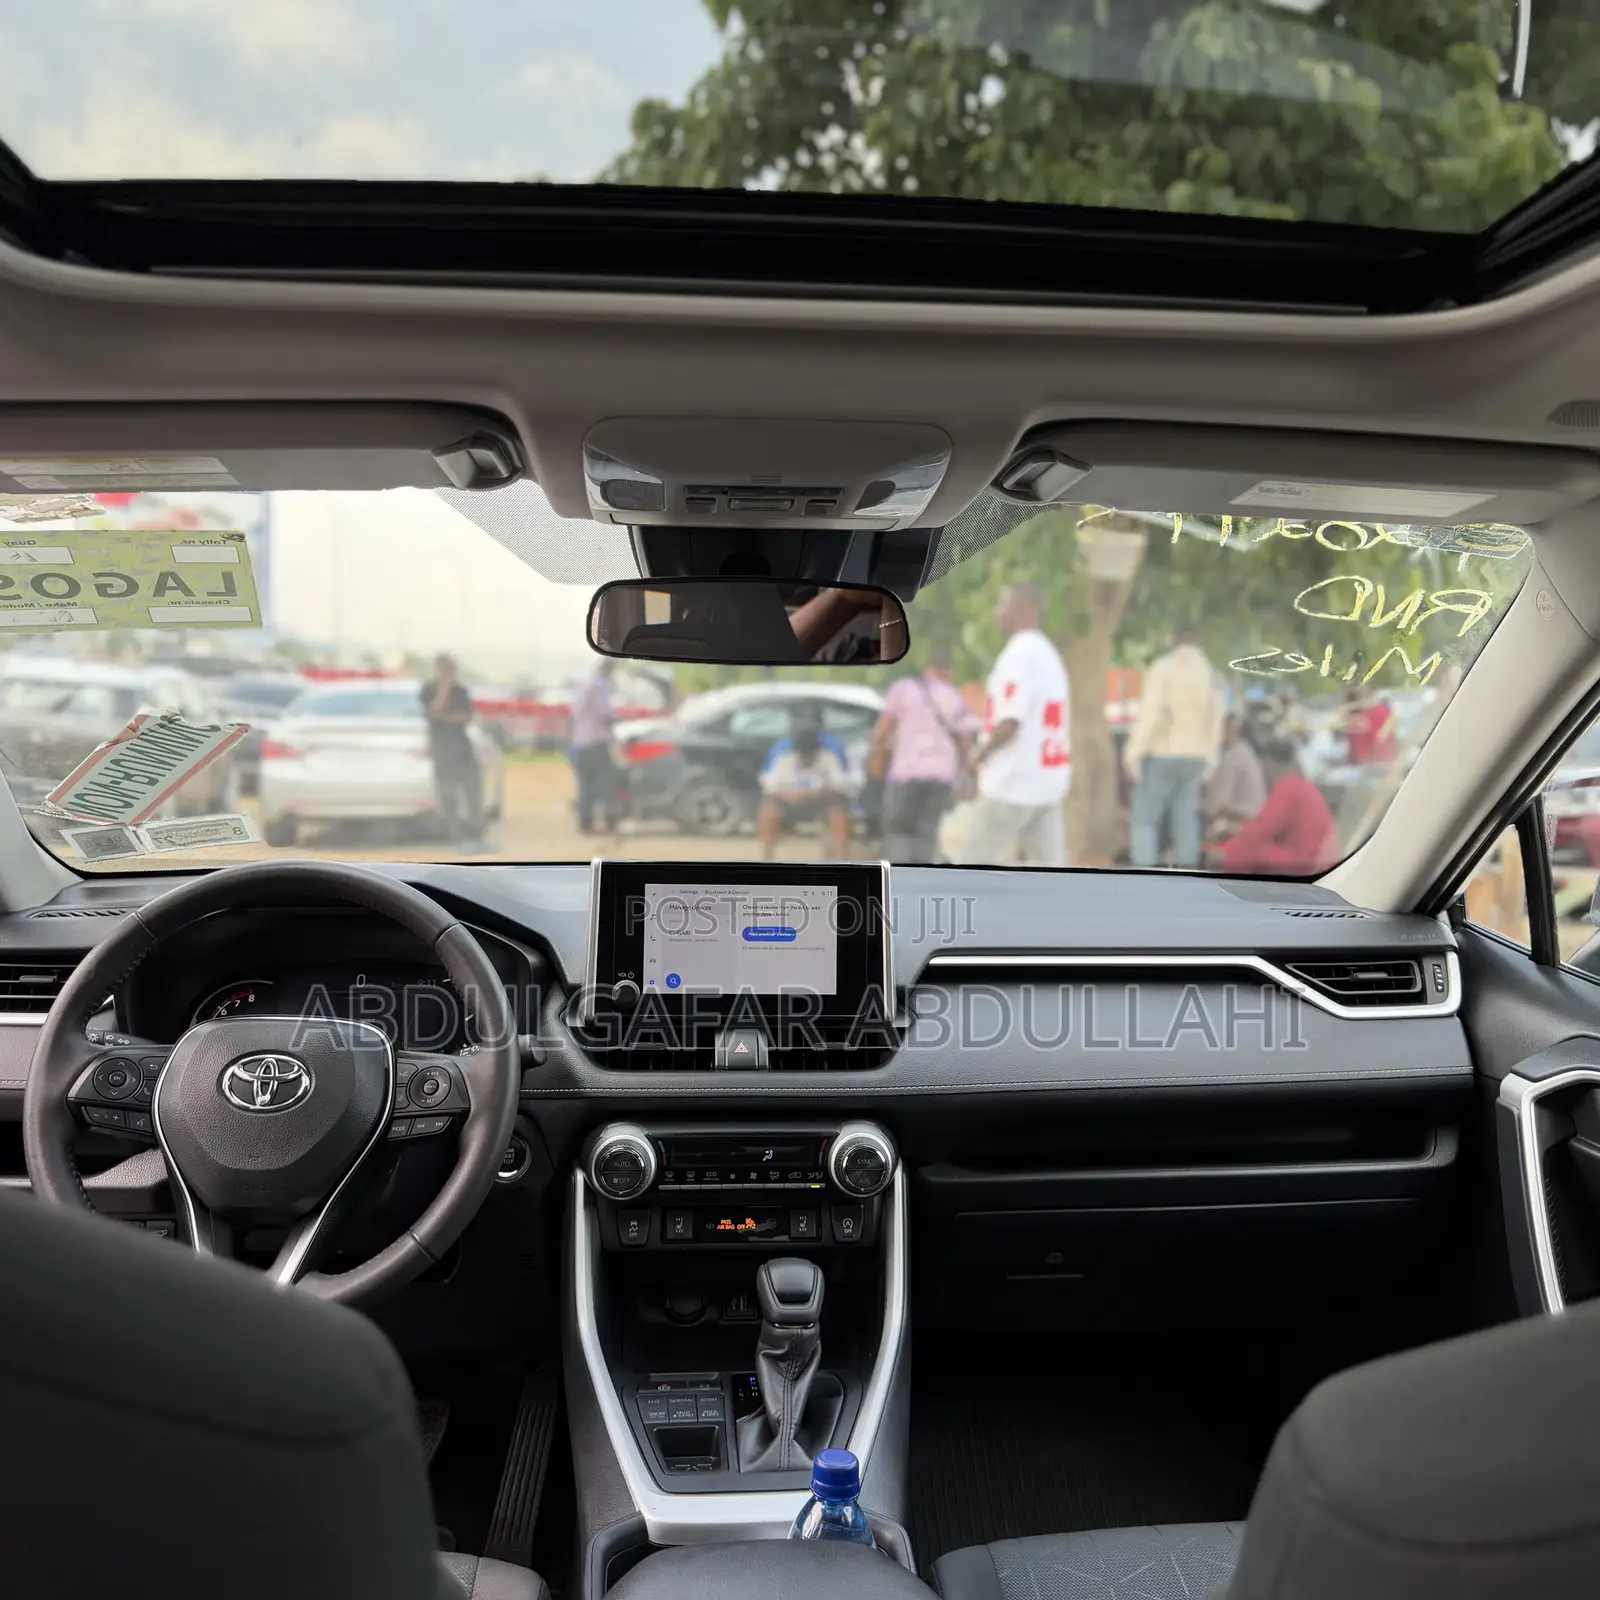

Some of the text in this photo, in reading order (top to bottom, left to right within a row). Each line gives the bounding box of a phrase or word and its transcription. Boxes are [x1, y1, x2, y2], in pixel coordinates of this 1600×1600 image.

[248, 994, 255, 1003] 8
[234, 1000, 241, 1008] 7
[220, 1008, 228, 1016] 6
[613, 1160, 631, 1168] AUTO
